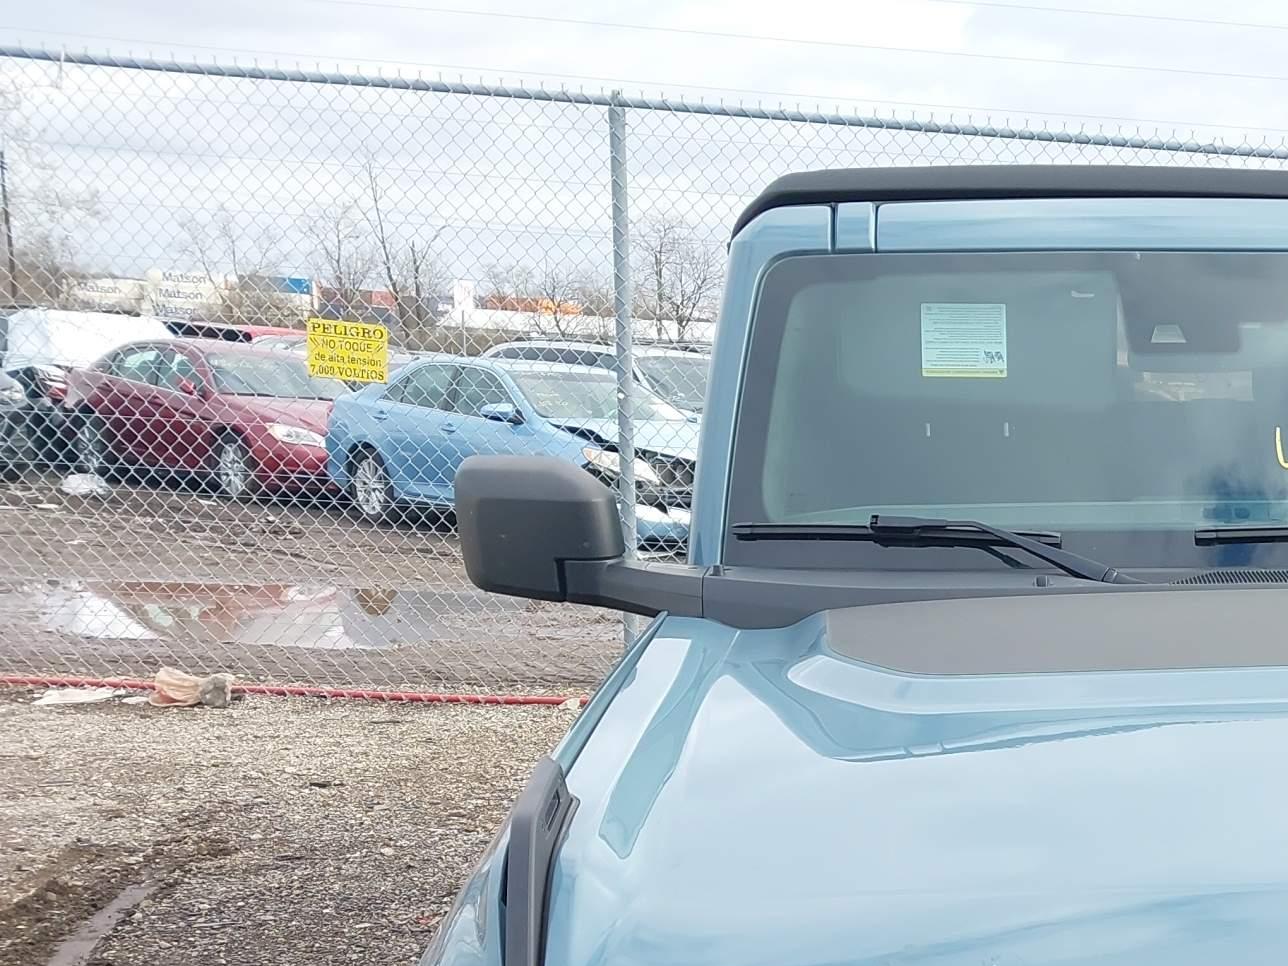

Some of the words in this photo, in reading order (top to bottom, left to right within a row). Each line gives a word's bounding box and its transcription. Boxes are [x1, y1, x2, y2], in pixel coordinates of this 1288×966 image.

[158, 287, 204, 300] Matson
[311, 322, 384, 340] PELIGRO
[321, 339, 336, 349] NO
[339, 340, 373, 353] TOQUE
[314, 351, 326, 361] de
[328, 353, 345, 363] alta
[337, 366, 385, 381] VOLTIOS
